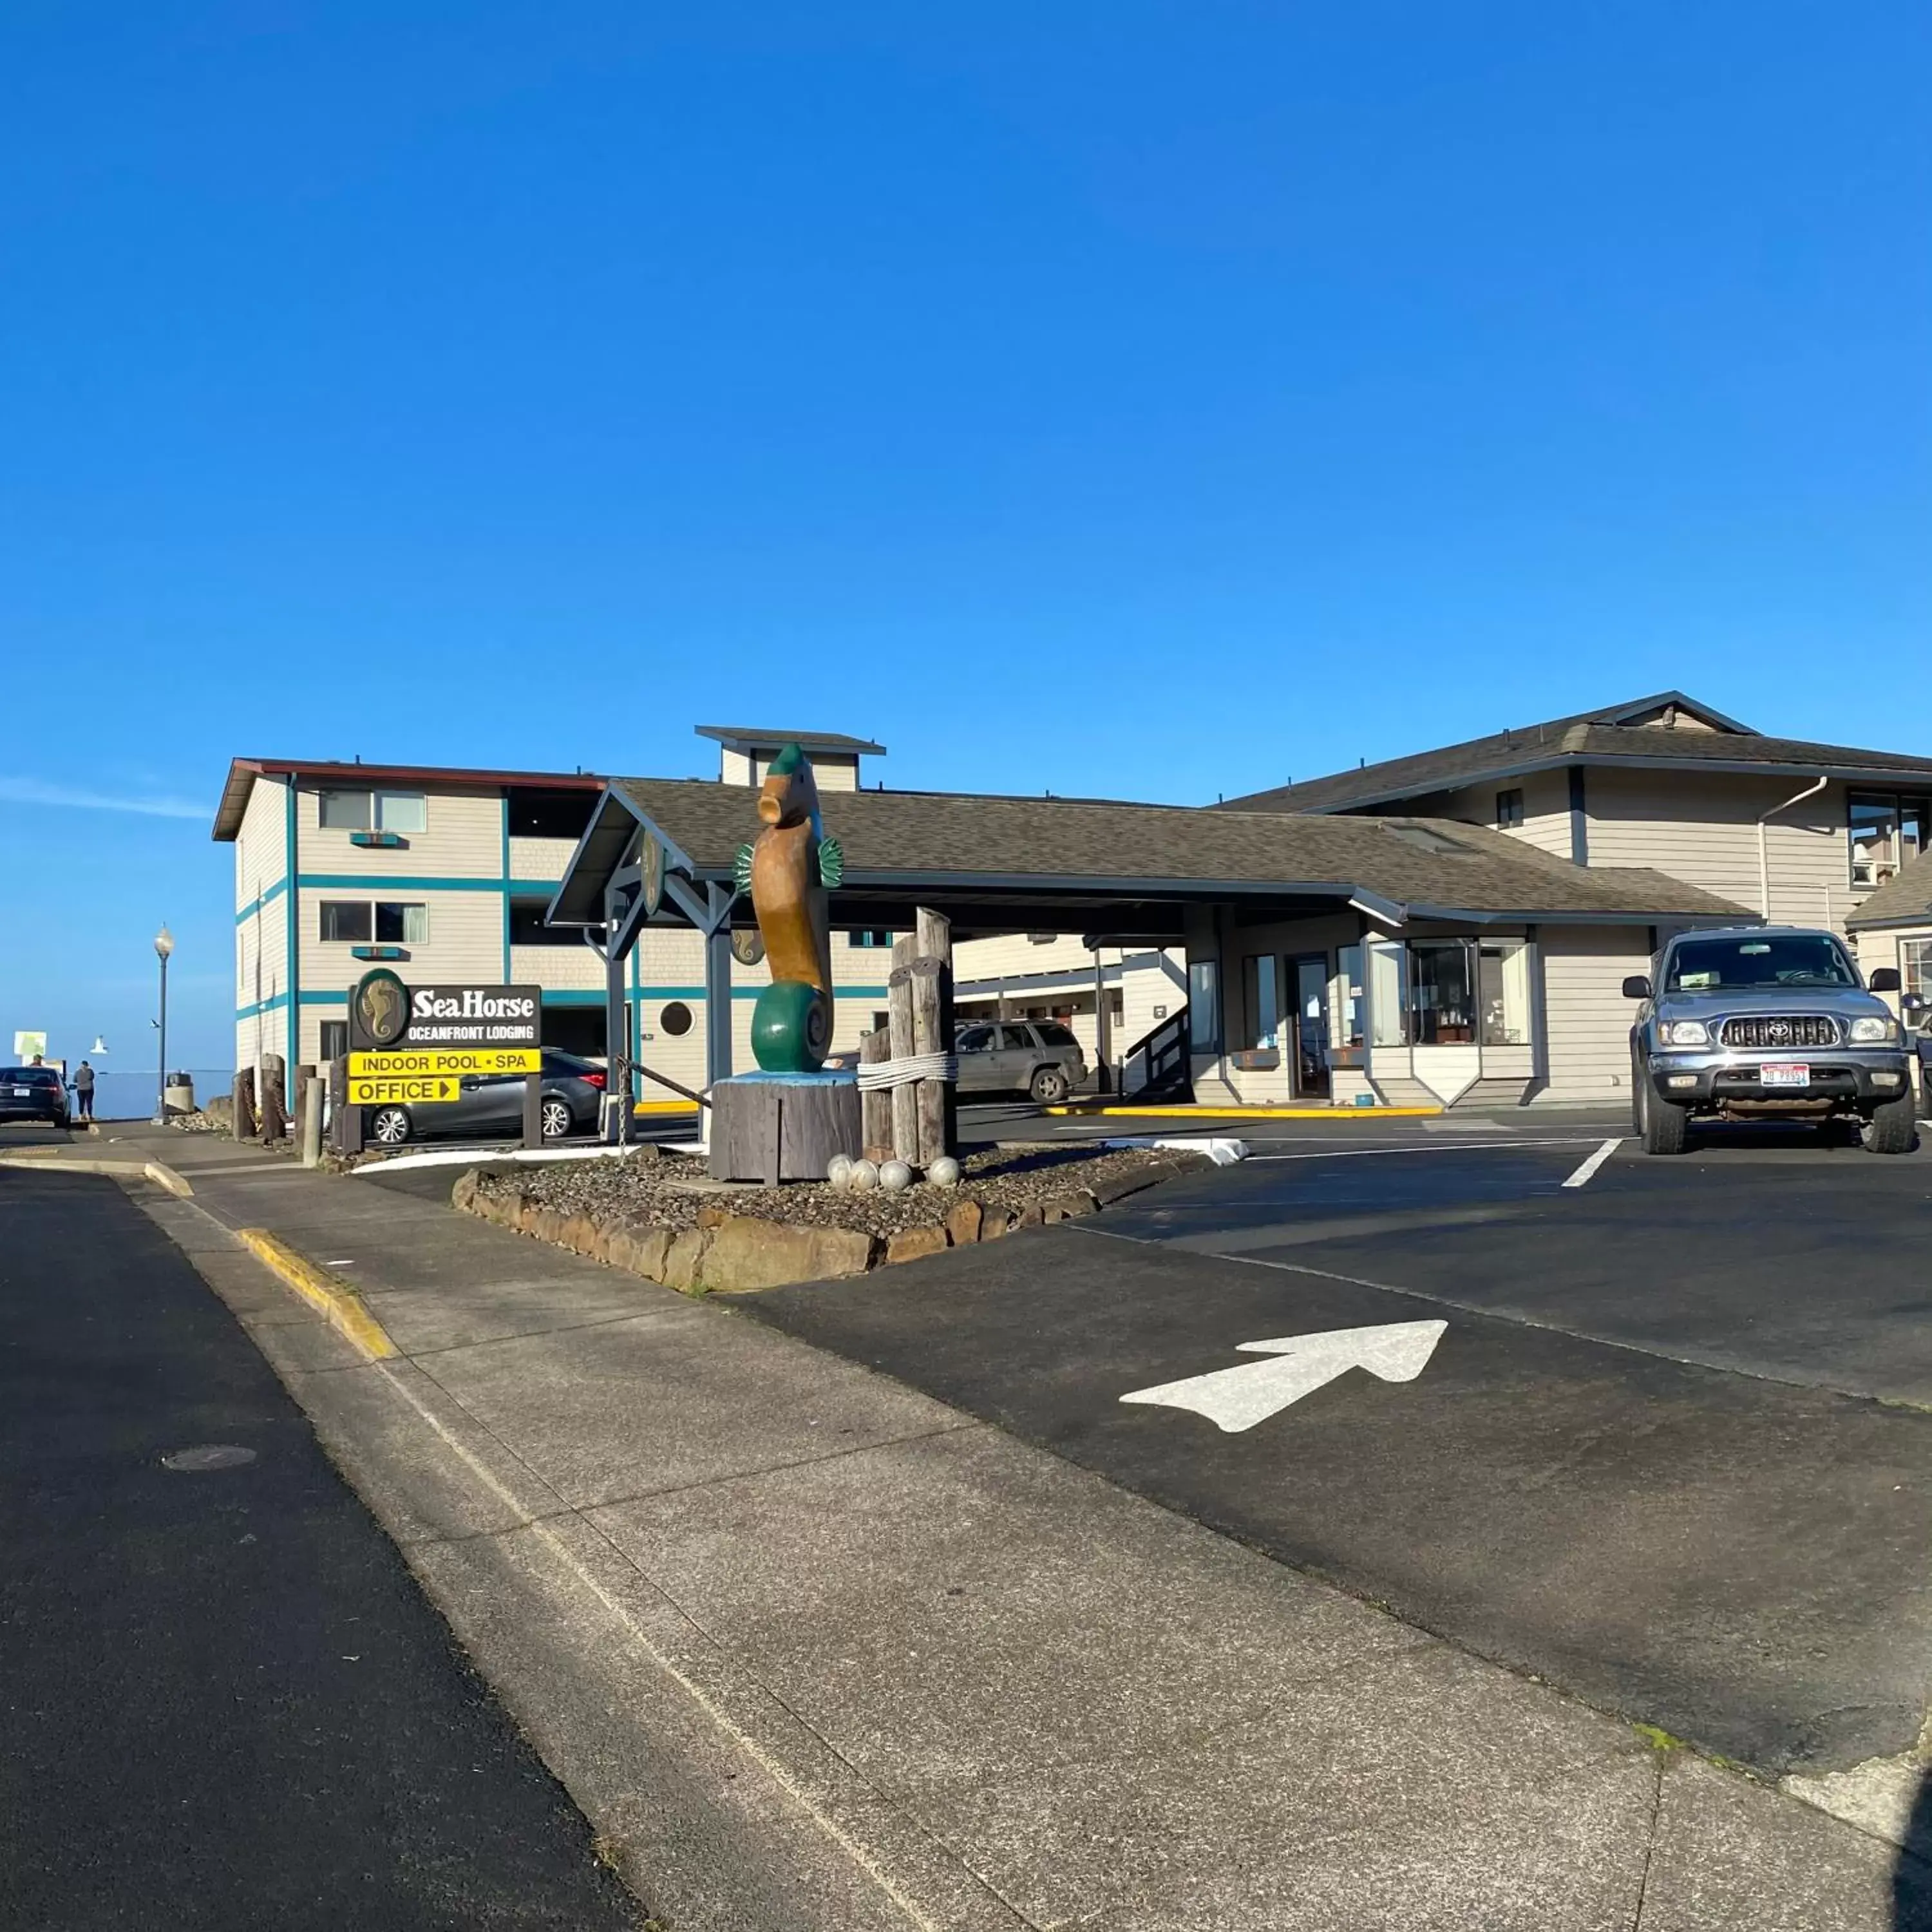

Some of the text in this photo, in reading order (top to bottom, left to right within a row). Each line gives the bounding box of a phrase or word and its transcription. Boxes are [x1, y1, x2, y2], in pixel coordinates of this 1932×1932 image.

[408, 1026, 534, 1041] OCEANFRONT LODGING
[363, 1055, 526, 1071] INDOOR POOL SPA
[358, 1082, 433, 1100] OFFICE
